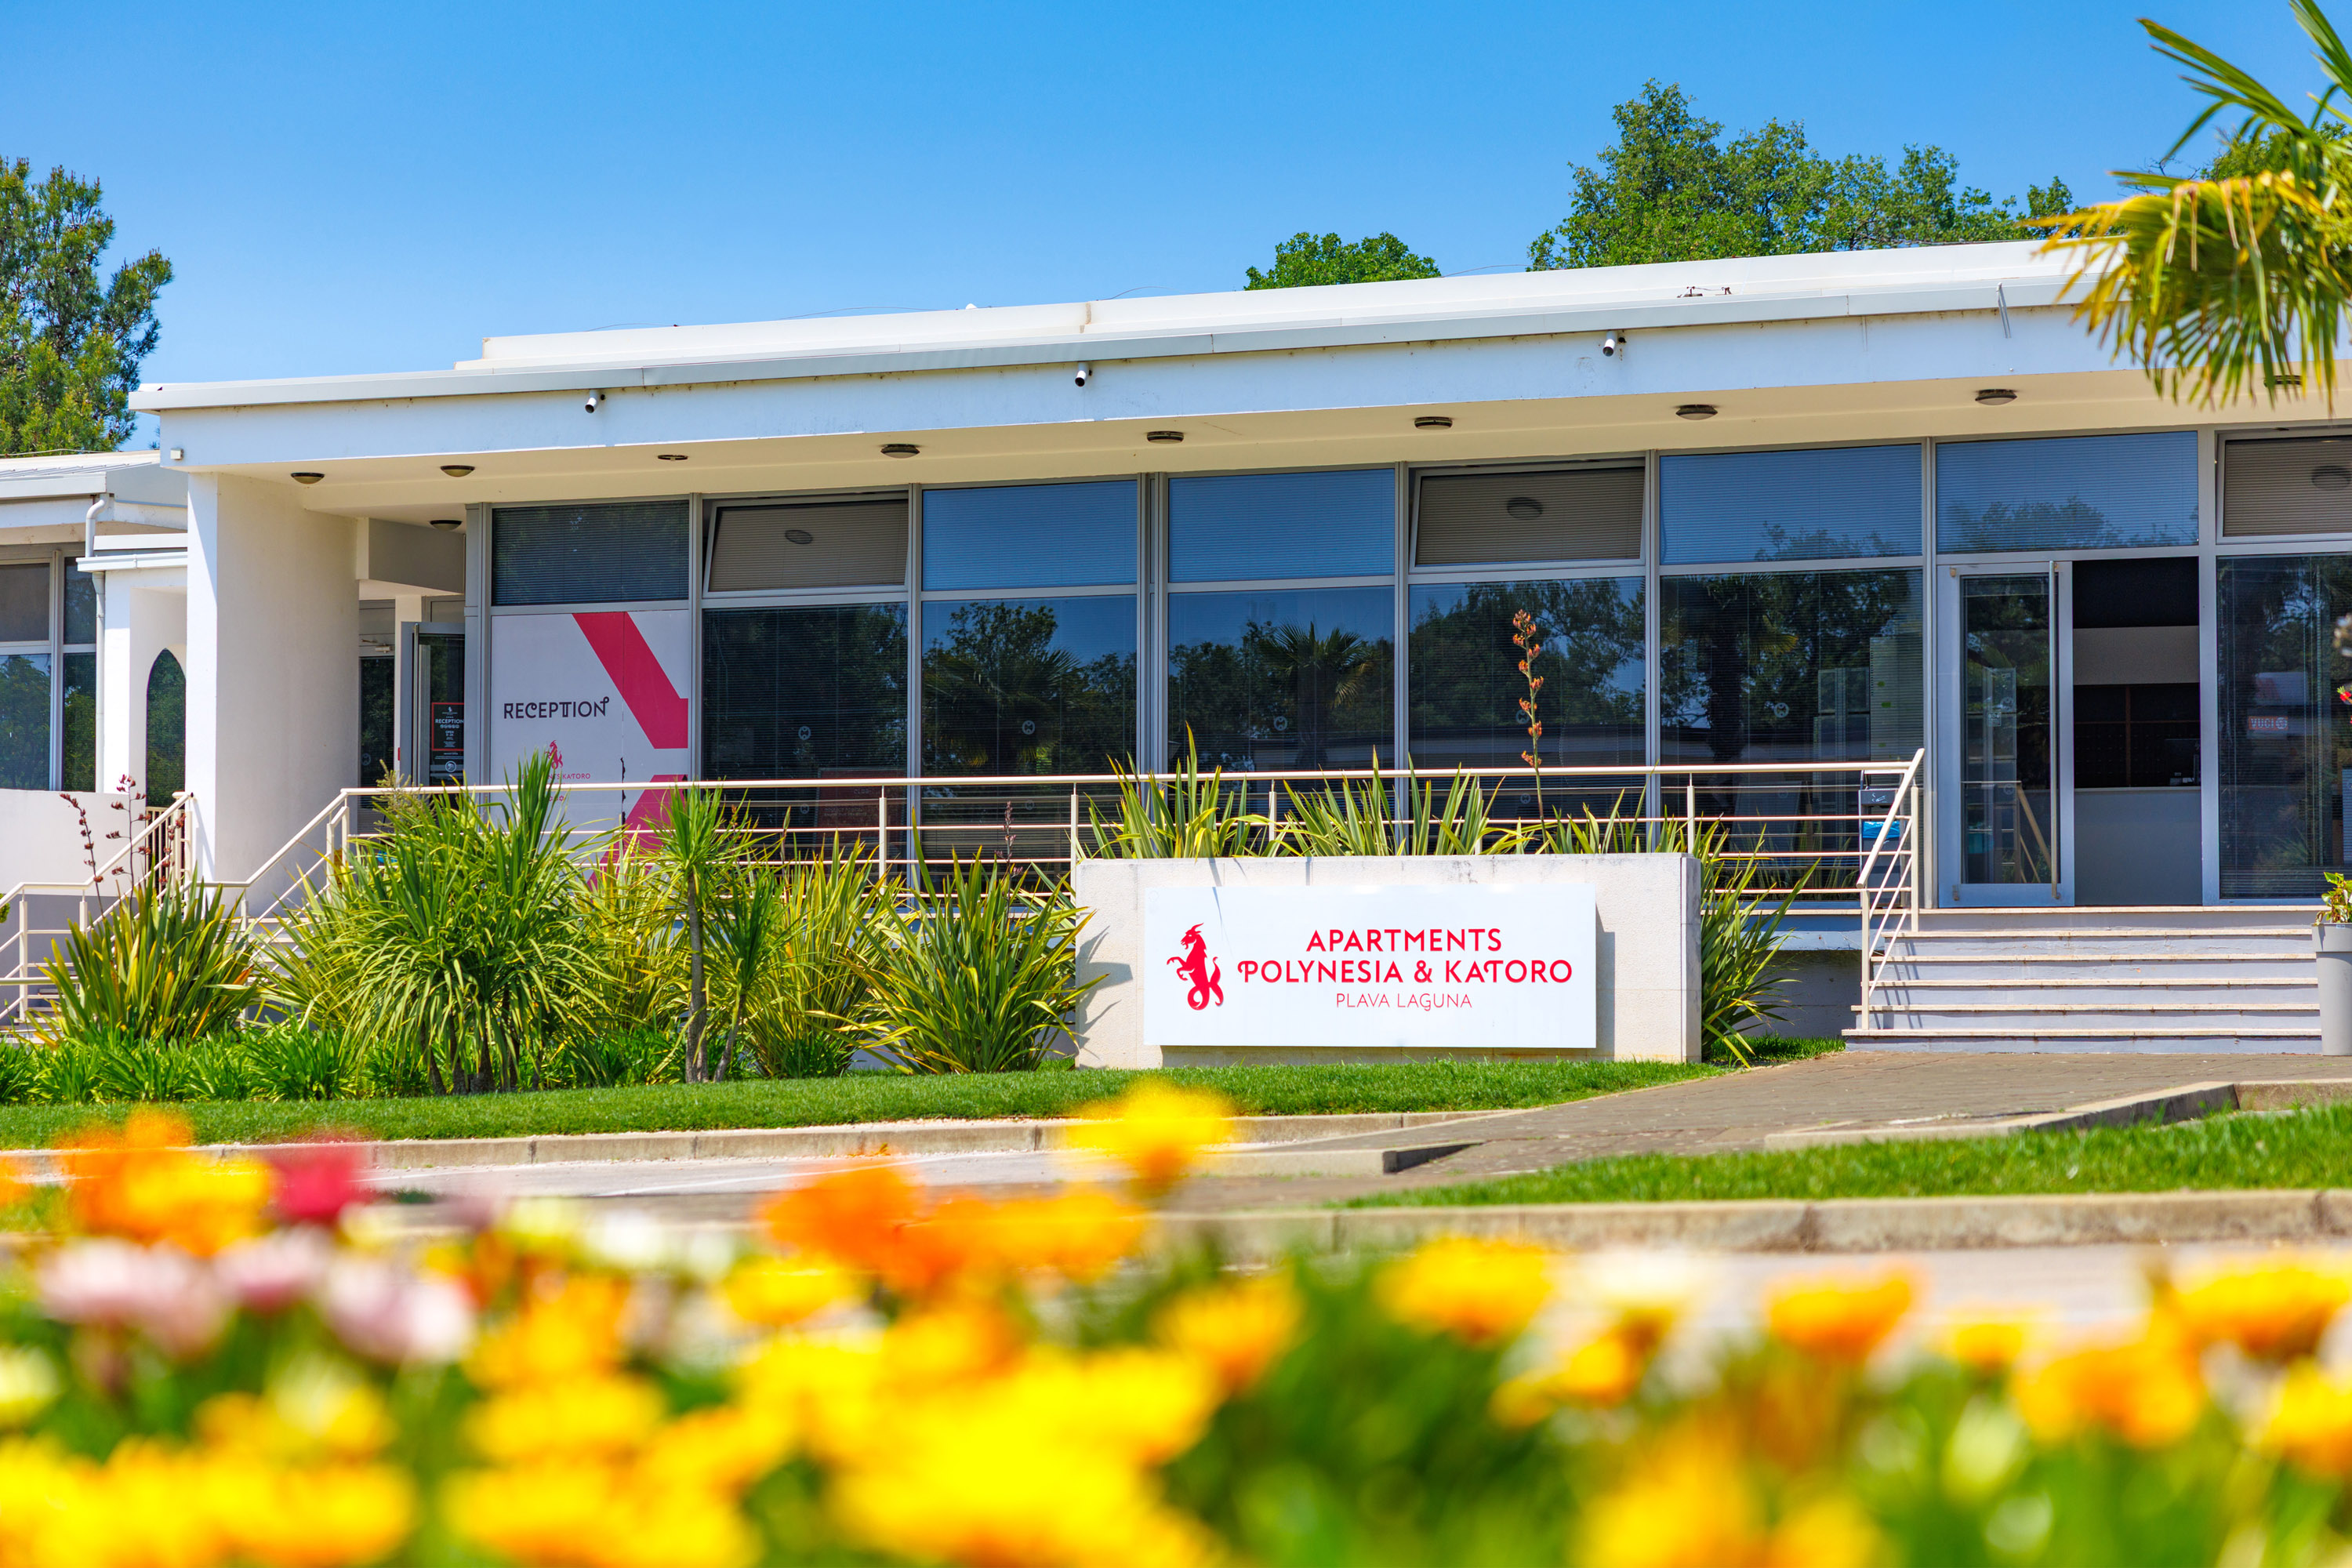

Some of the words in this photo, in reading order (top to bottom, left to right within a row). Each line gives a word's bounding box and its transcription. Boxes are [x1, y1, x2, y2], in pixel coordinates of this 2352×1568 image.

[503, 696, 610, 719] RECEPTION
[1306, 928, 1501, 953] APARTMENTS
[1237, 960, 1403, 984] POLYNESIA
[1414, 960, 1433, 984] &
[1445, 960, 1573, 984] KATORO
[1336, 993, 1390, 1009] PLAVA
[1397, 993, 1472, 1011] LAGUNA
